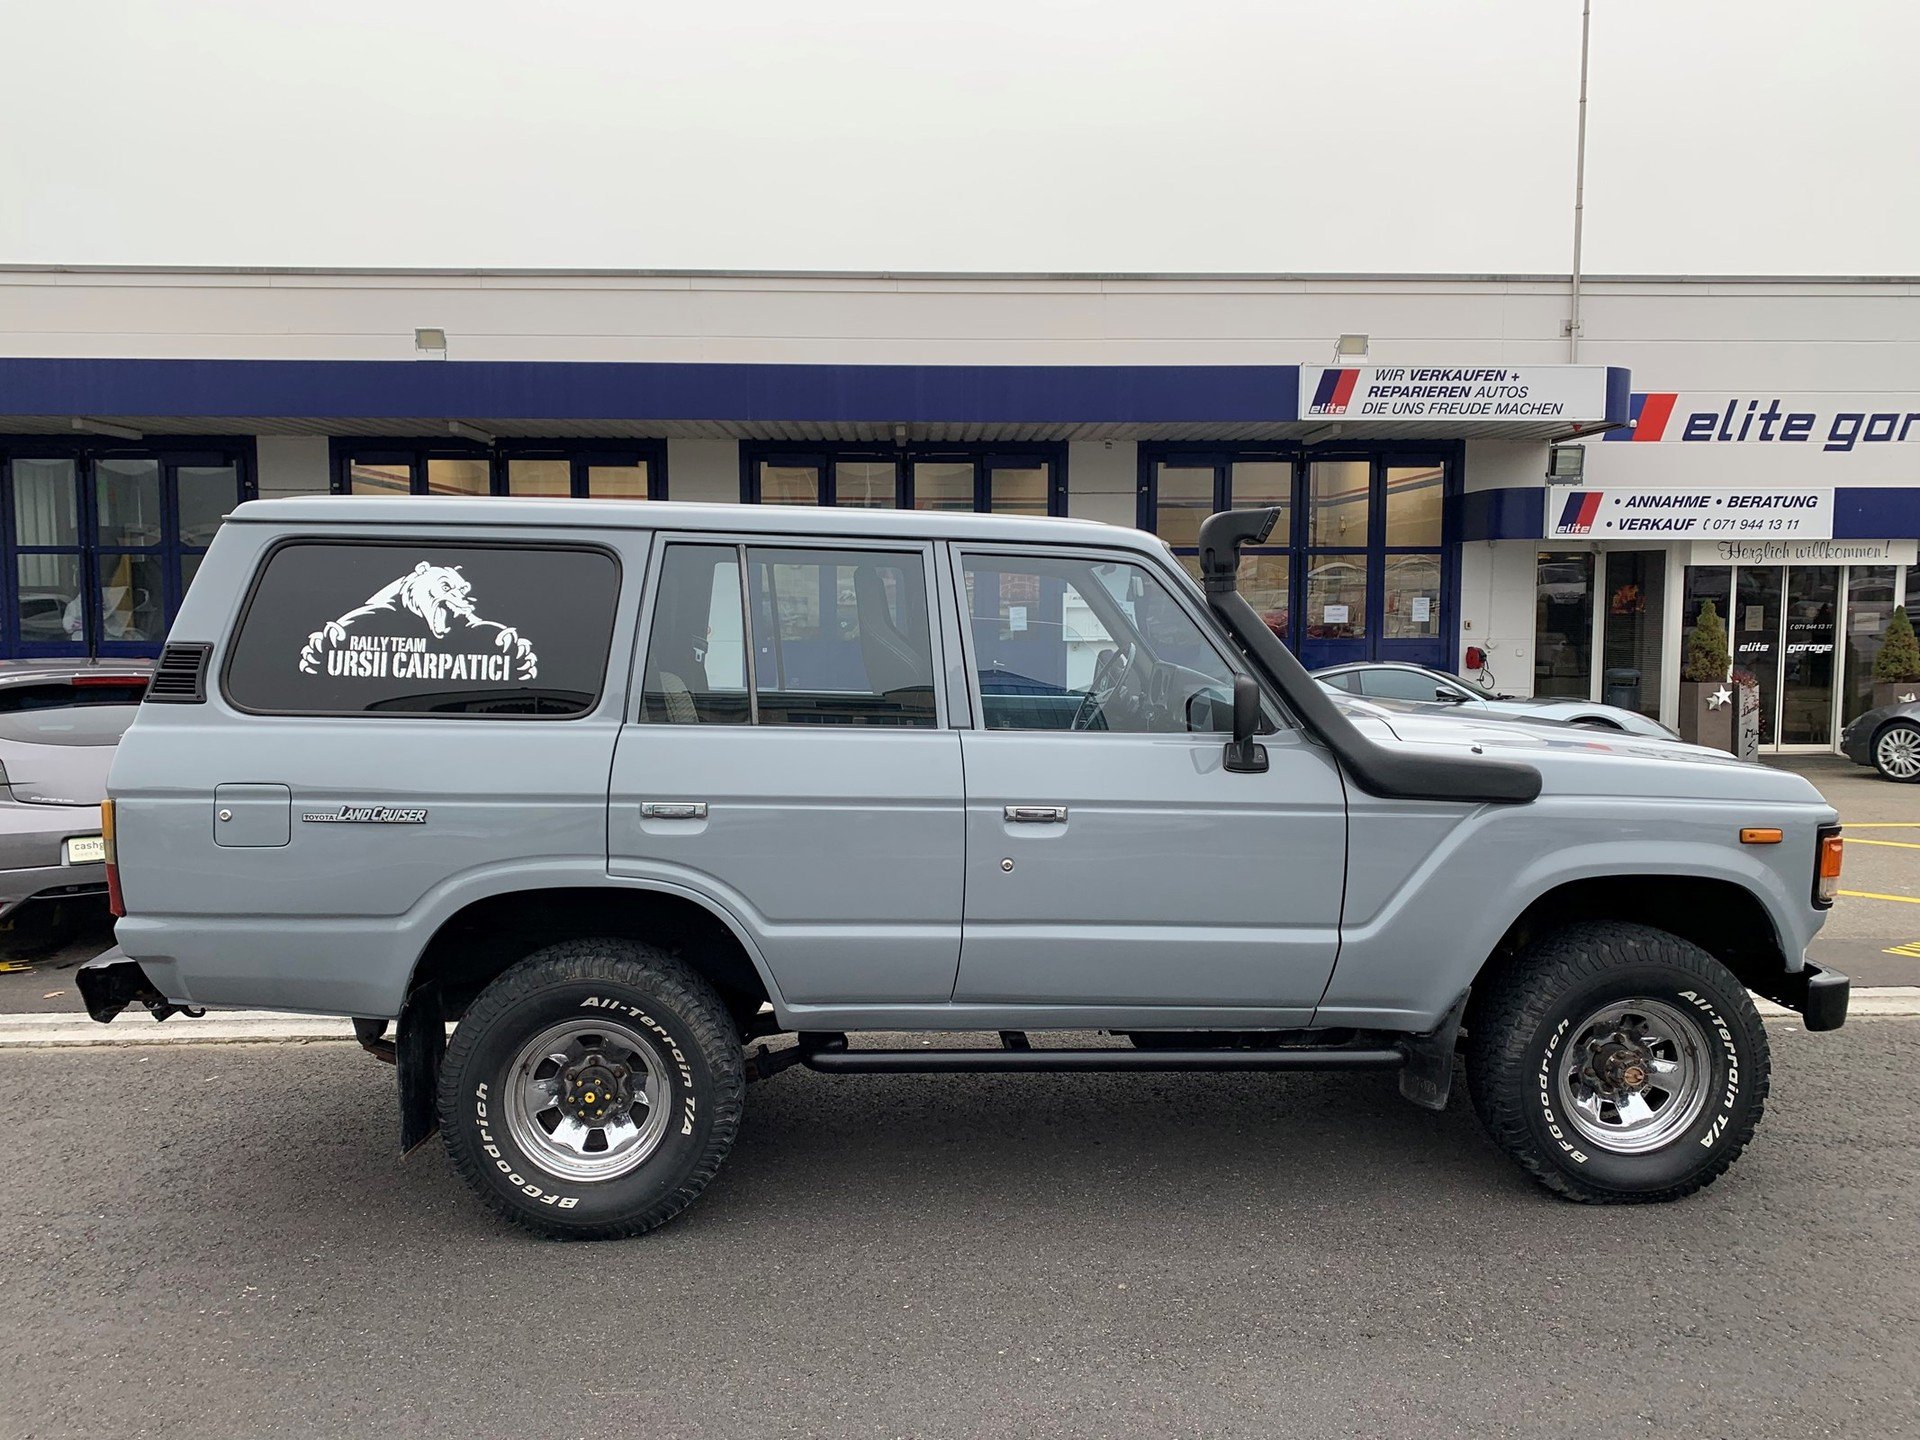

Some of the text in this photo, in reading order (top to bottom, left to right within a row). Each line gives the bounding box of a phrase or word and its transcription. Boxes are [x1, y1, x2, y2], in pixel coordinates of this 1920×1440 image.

[1375, 369, 1405, 381] WIR
[1409, 369, 1508, 382] VERKAUFEN
[1367, 386, 1529, 398] REPARIEREN AUTOS
[1309, 403, 1347, 415] elite
[1361, 402, 1564, 415] DIE UNS FREUDE MACHEN
[1681, 399, 1817, 441] elite
[1625, 496, 1818, 508] ANNAHME BERATUNG
[1556, 524, 1591, 534] elite
[1619, 518, 1800, 530] VERKAUF 071 944 13 11
[1717, 540, 1790, 564] Herzlich
[350, 635, 426, 653] RALLY TEAM
[1739, 642, 1833, 654] elite garage
[327, 650, 510, 681] URSII CARPATICI
[580, 997, 696, 1136] All-Terrain T/A
[1678, 990, 1740, 1149] All-Terrain T/A
[1537, 1018, 1589, 1164] BFGoodrich
[476, 1083, 580, 1209] BFGoodrich
